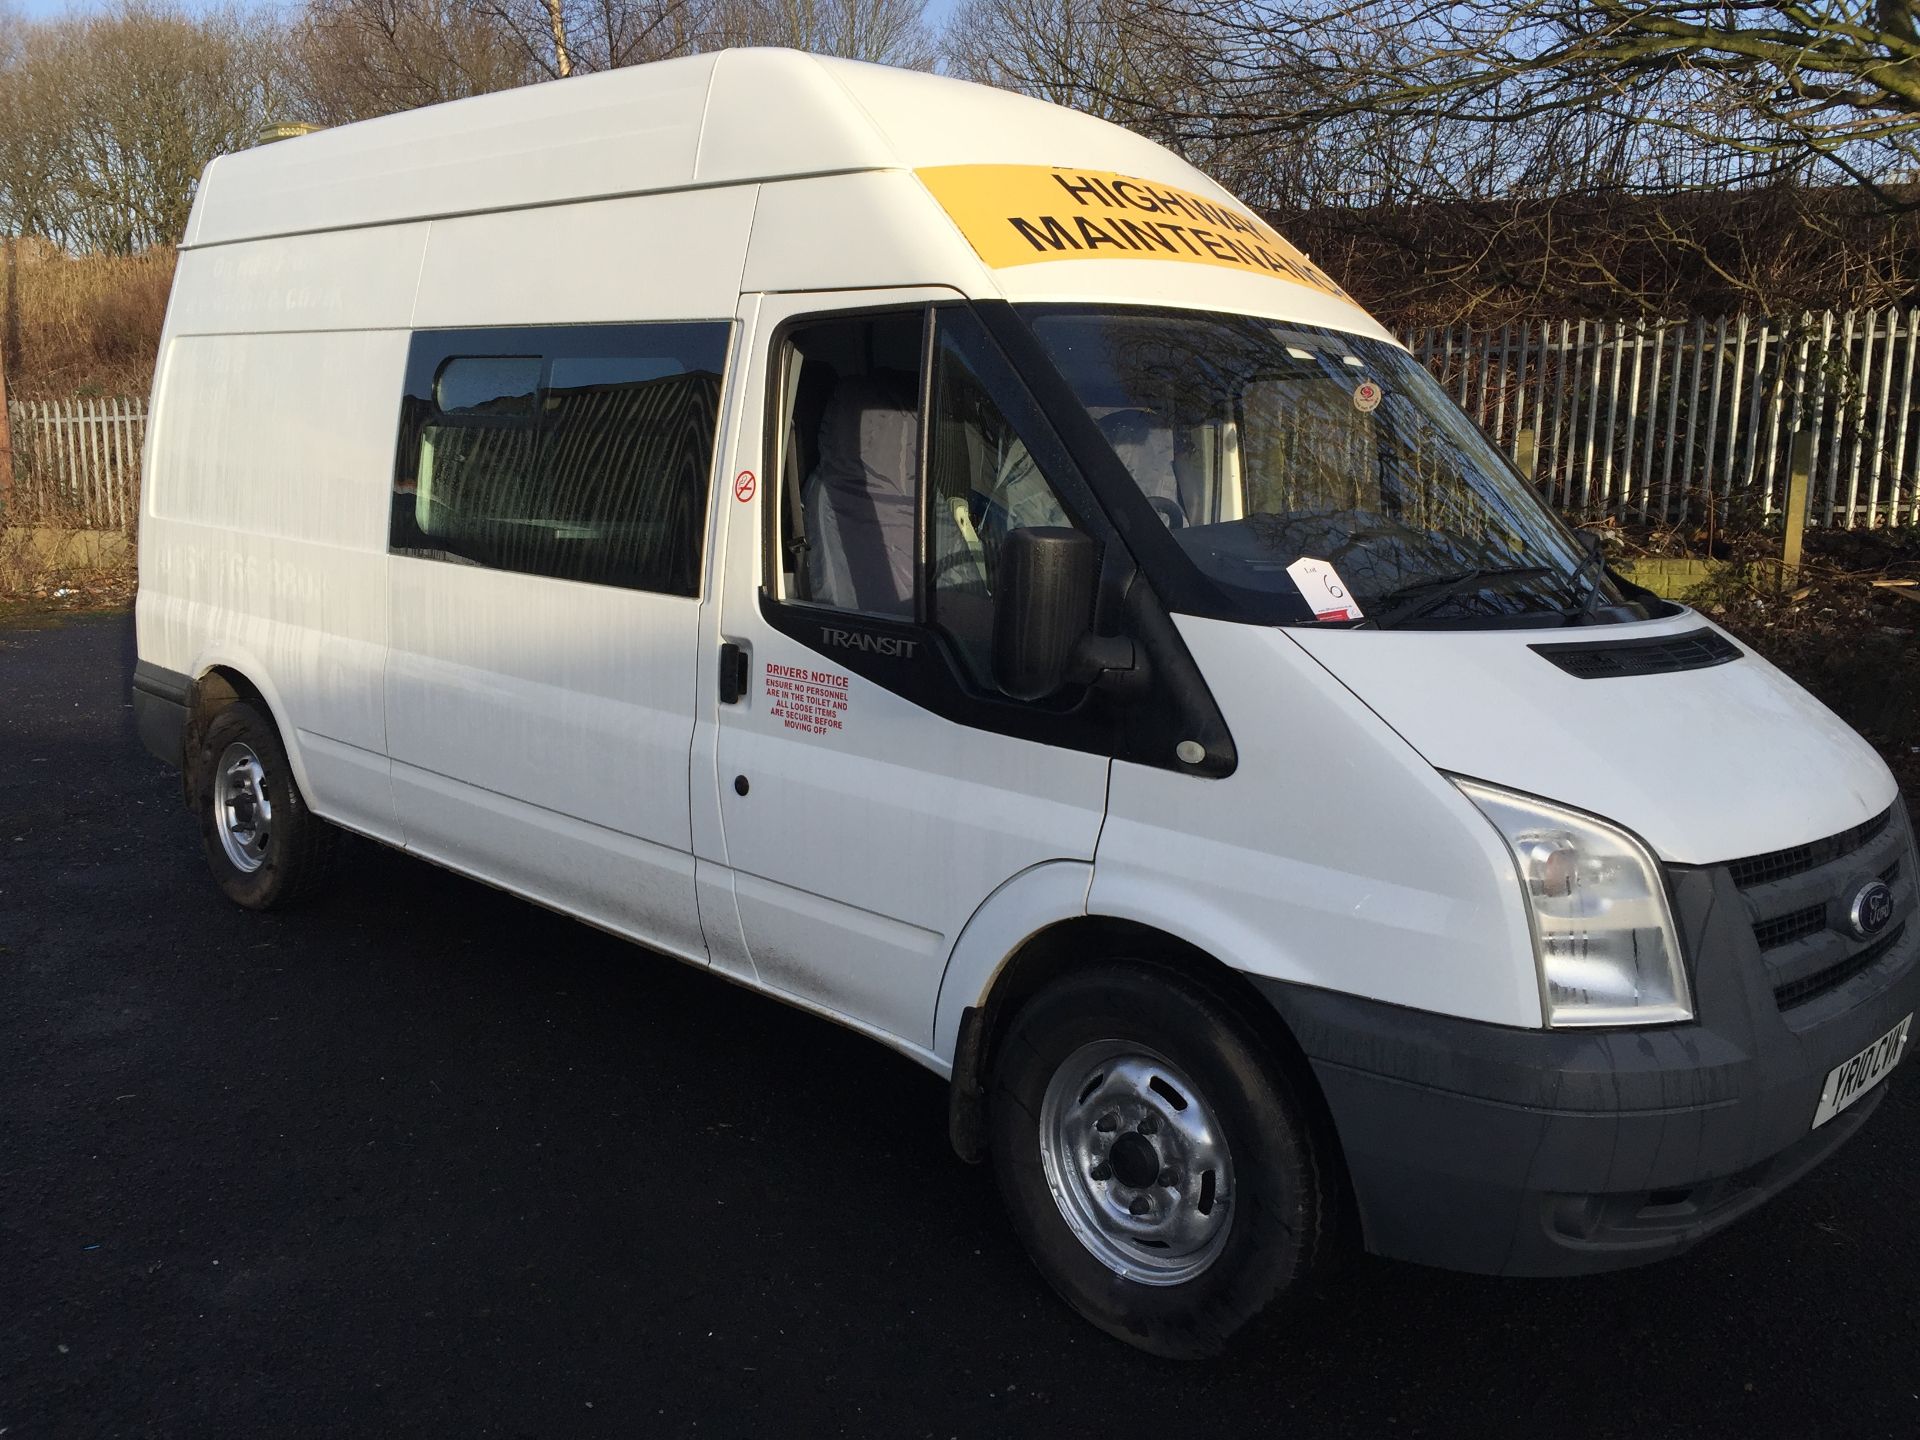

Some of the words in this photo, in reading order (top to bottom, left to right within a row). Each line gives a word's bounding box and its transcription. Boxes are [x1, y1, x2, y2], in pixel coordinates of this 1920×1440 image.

[1051, 174, 1271, 245] HIGHWAY
[1007, 216, 1344, 298] MAINTENANC
[1323, 574, 1343, 598] 6
[820, 627, 918, 658] TRANSIT
[766, 663, 808, 680] DRIVERS
[811, 671, 849, 688] NOTICE
[766, 678, 792, 691] ENSURE
[794, 684, 805, 693] NO
[806, 686, 848, 701] PERSONNEL
[766, 688, 780, 697] ARE
[791, 693, 804, 702] THE
[806, 696, 831, 708] TOILET
[832, 701, 848, 711] AND
[770, 707, 784, 717] ARE
[785, 710, 813, 724] SECURE
[814, 716, 843, 730] BEFORE
[776, 699, 789, 709] ALL
[790, 702, 813, 714] LOOSE
[814, 707, 837, 719] ITEMS
[784, 720, 812, 733] MOVING
[813, 726, 827, 736] OFF
[1869, 893, 1890, 926] Ford
